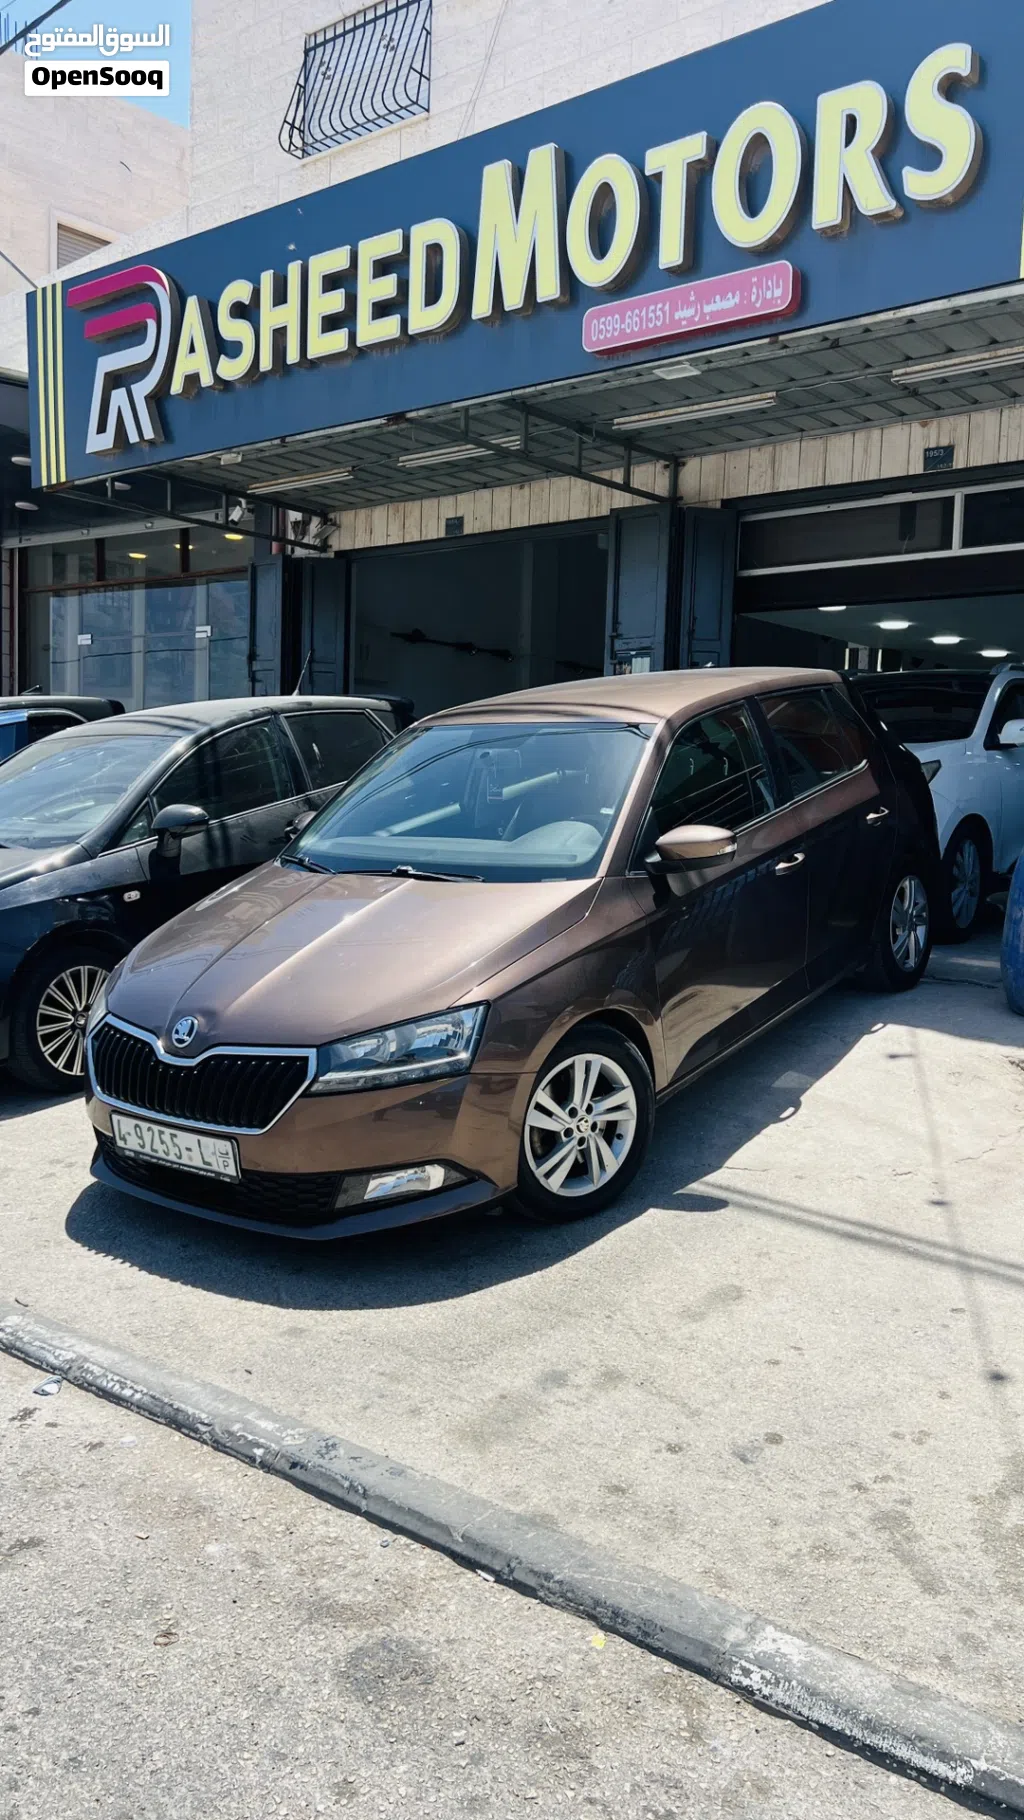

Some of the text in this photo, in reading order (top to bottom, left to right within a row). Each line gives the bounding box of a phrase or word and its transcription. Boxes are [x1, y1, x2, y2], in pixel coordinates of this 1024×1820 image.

[471, 42, 978, 321] MOTORS
[591, 301, 670, 342] 0599-661551
[674, 289, 701, 327] رشيد
